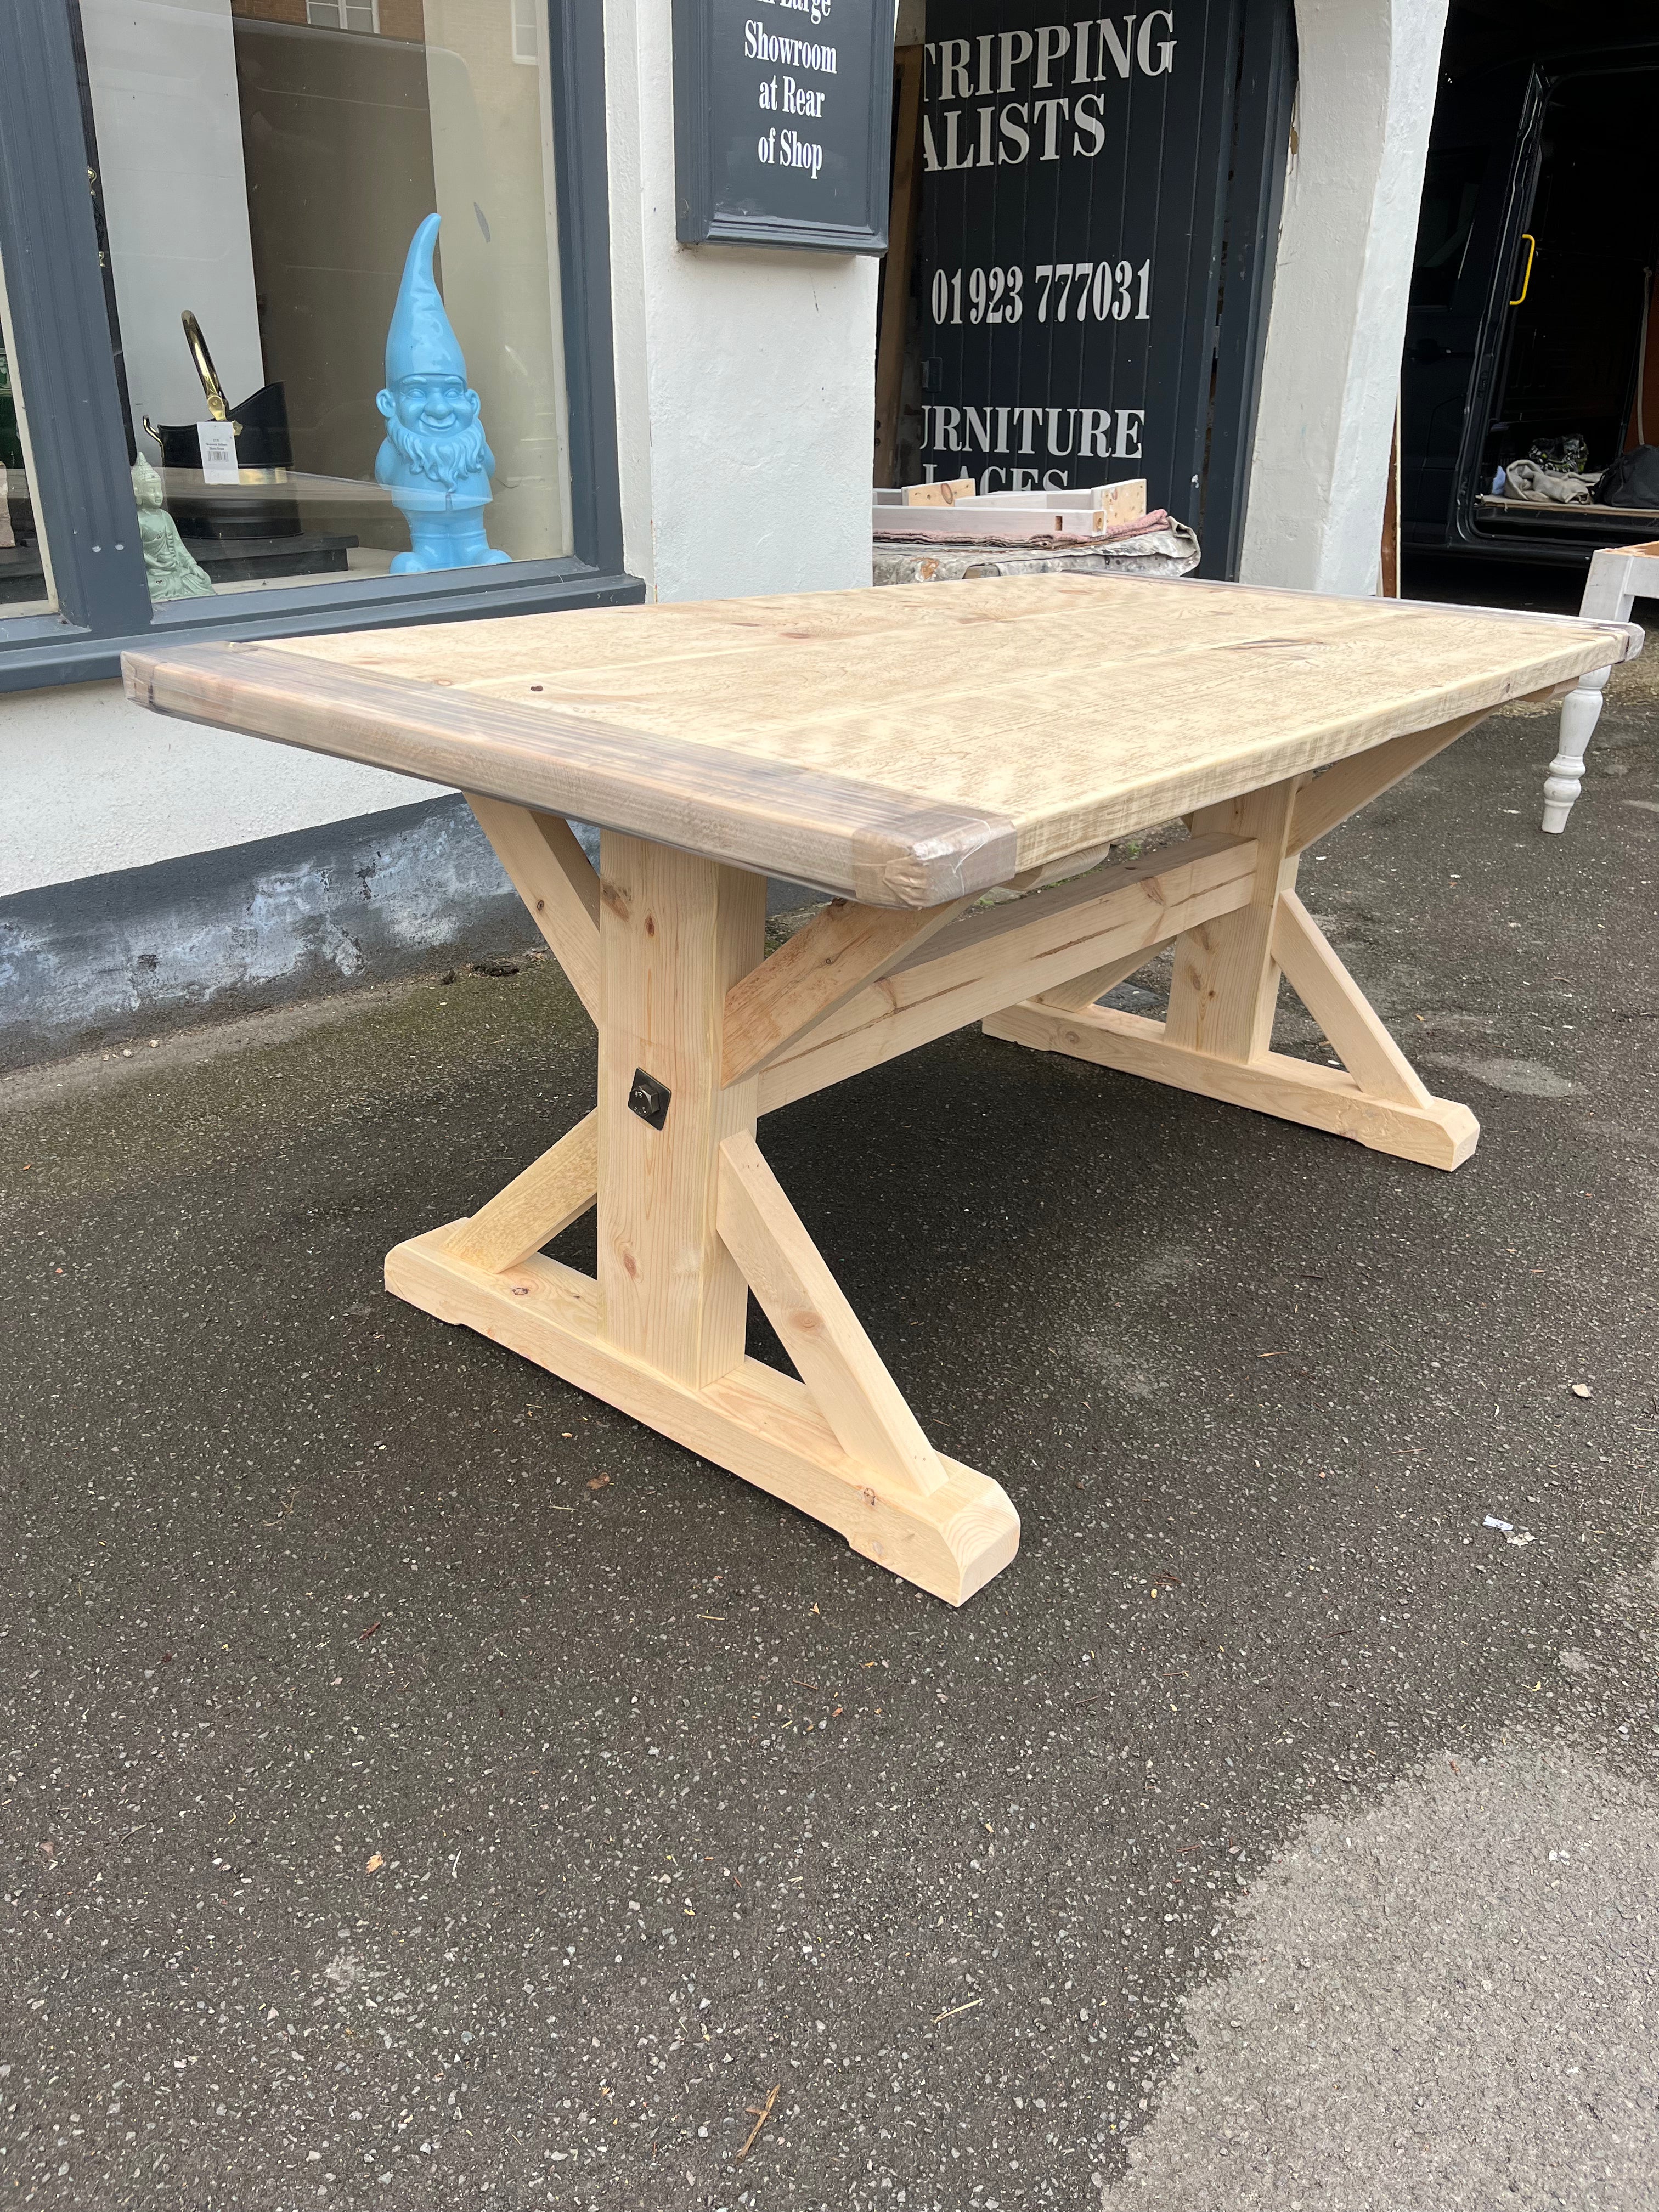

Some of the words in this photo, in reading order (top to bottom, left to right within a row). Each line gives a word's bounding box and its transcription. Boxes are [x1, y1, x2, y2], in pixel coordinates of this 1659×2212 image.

[744, 19, 837, 74] Showroom
[759, 75, 778, 111] at
[782, 76, 825, 118] Rear
[758, 127, 776, 164] of
[780, 129, 822, 179] Shop
[932, 266, 1023, 325] 01923
[1035, 259, 1150, 323] 777031
[919, 405, 1146, 459] RNITURE
